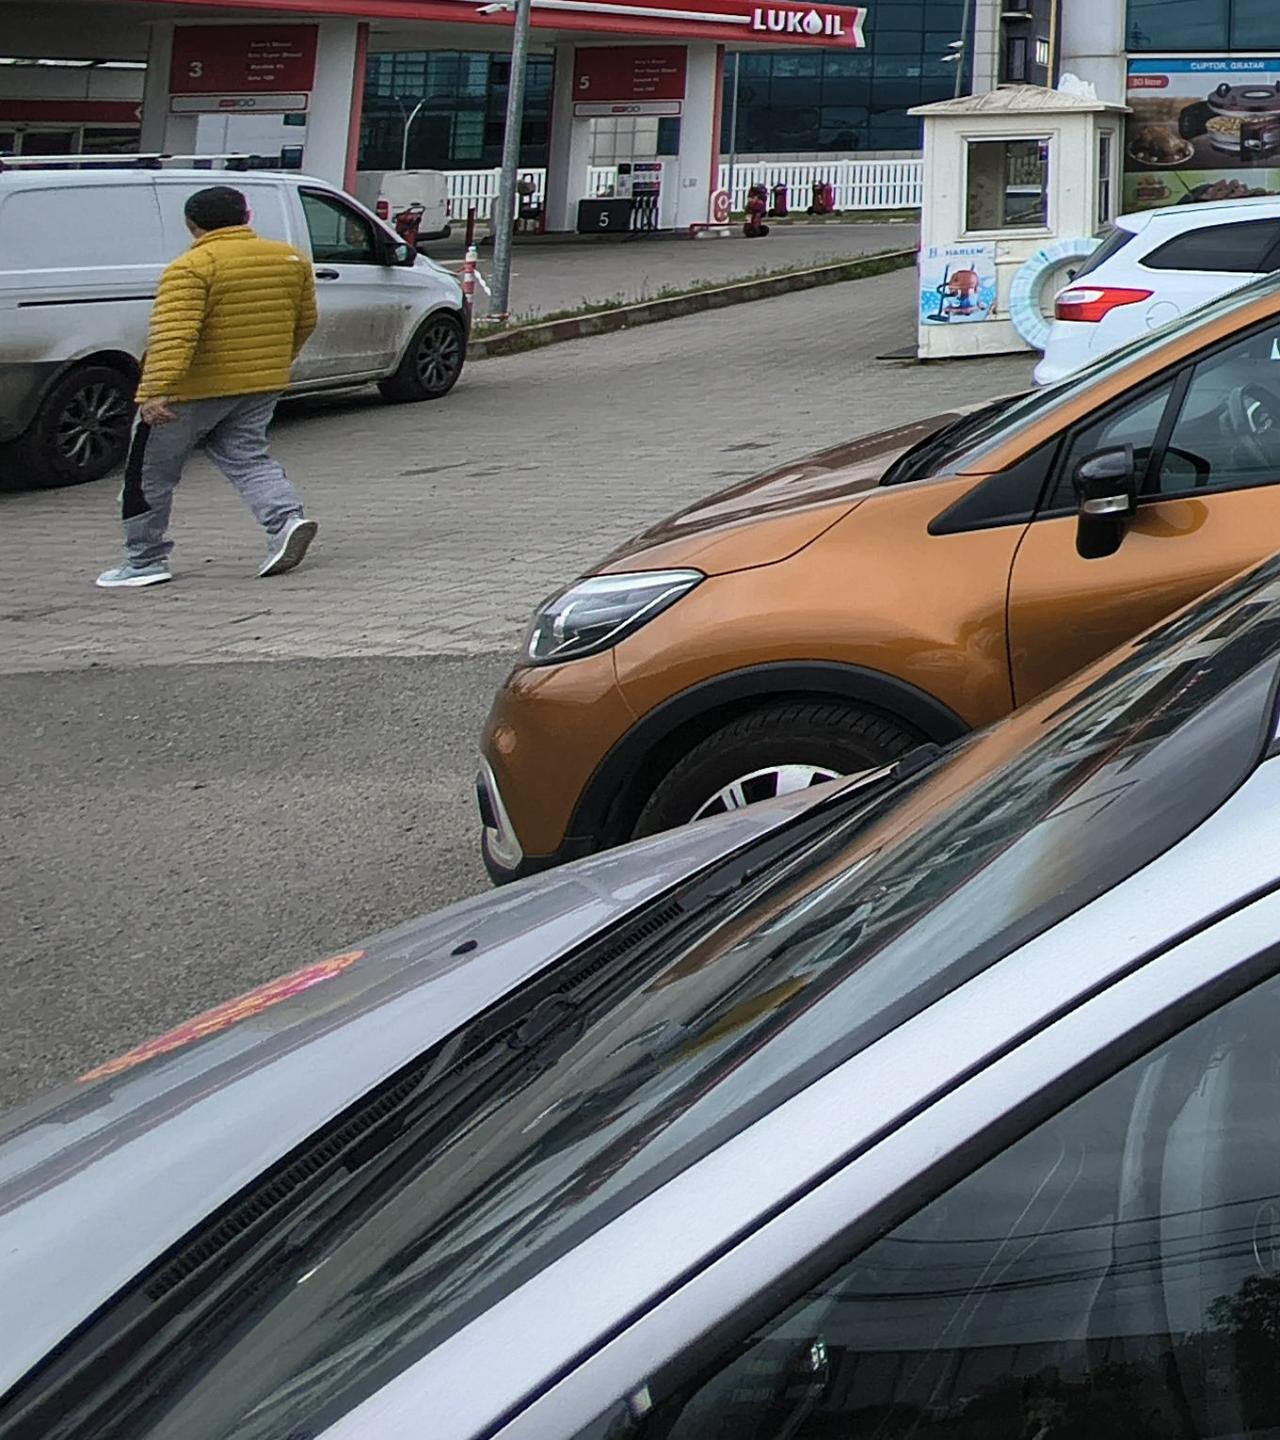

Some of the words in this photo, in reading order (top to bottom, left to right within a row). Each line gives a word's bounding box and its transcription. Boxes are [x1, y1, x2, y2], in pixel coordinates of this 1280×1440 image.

[753, 8, 845, 35] LUKOIL
[188, 61, 202, 78] 3
[579, 75, 590, 89] 5
[598, 211, 609, 228] 5
